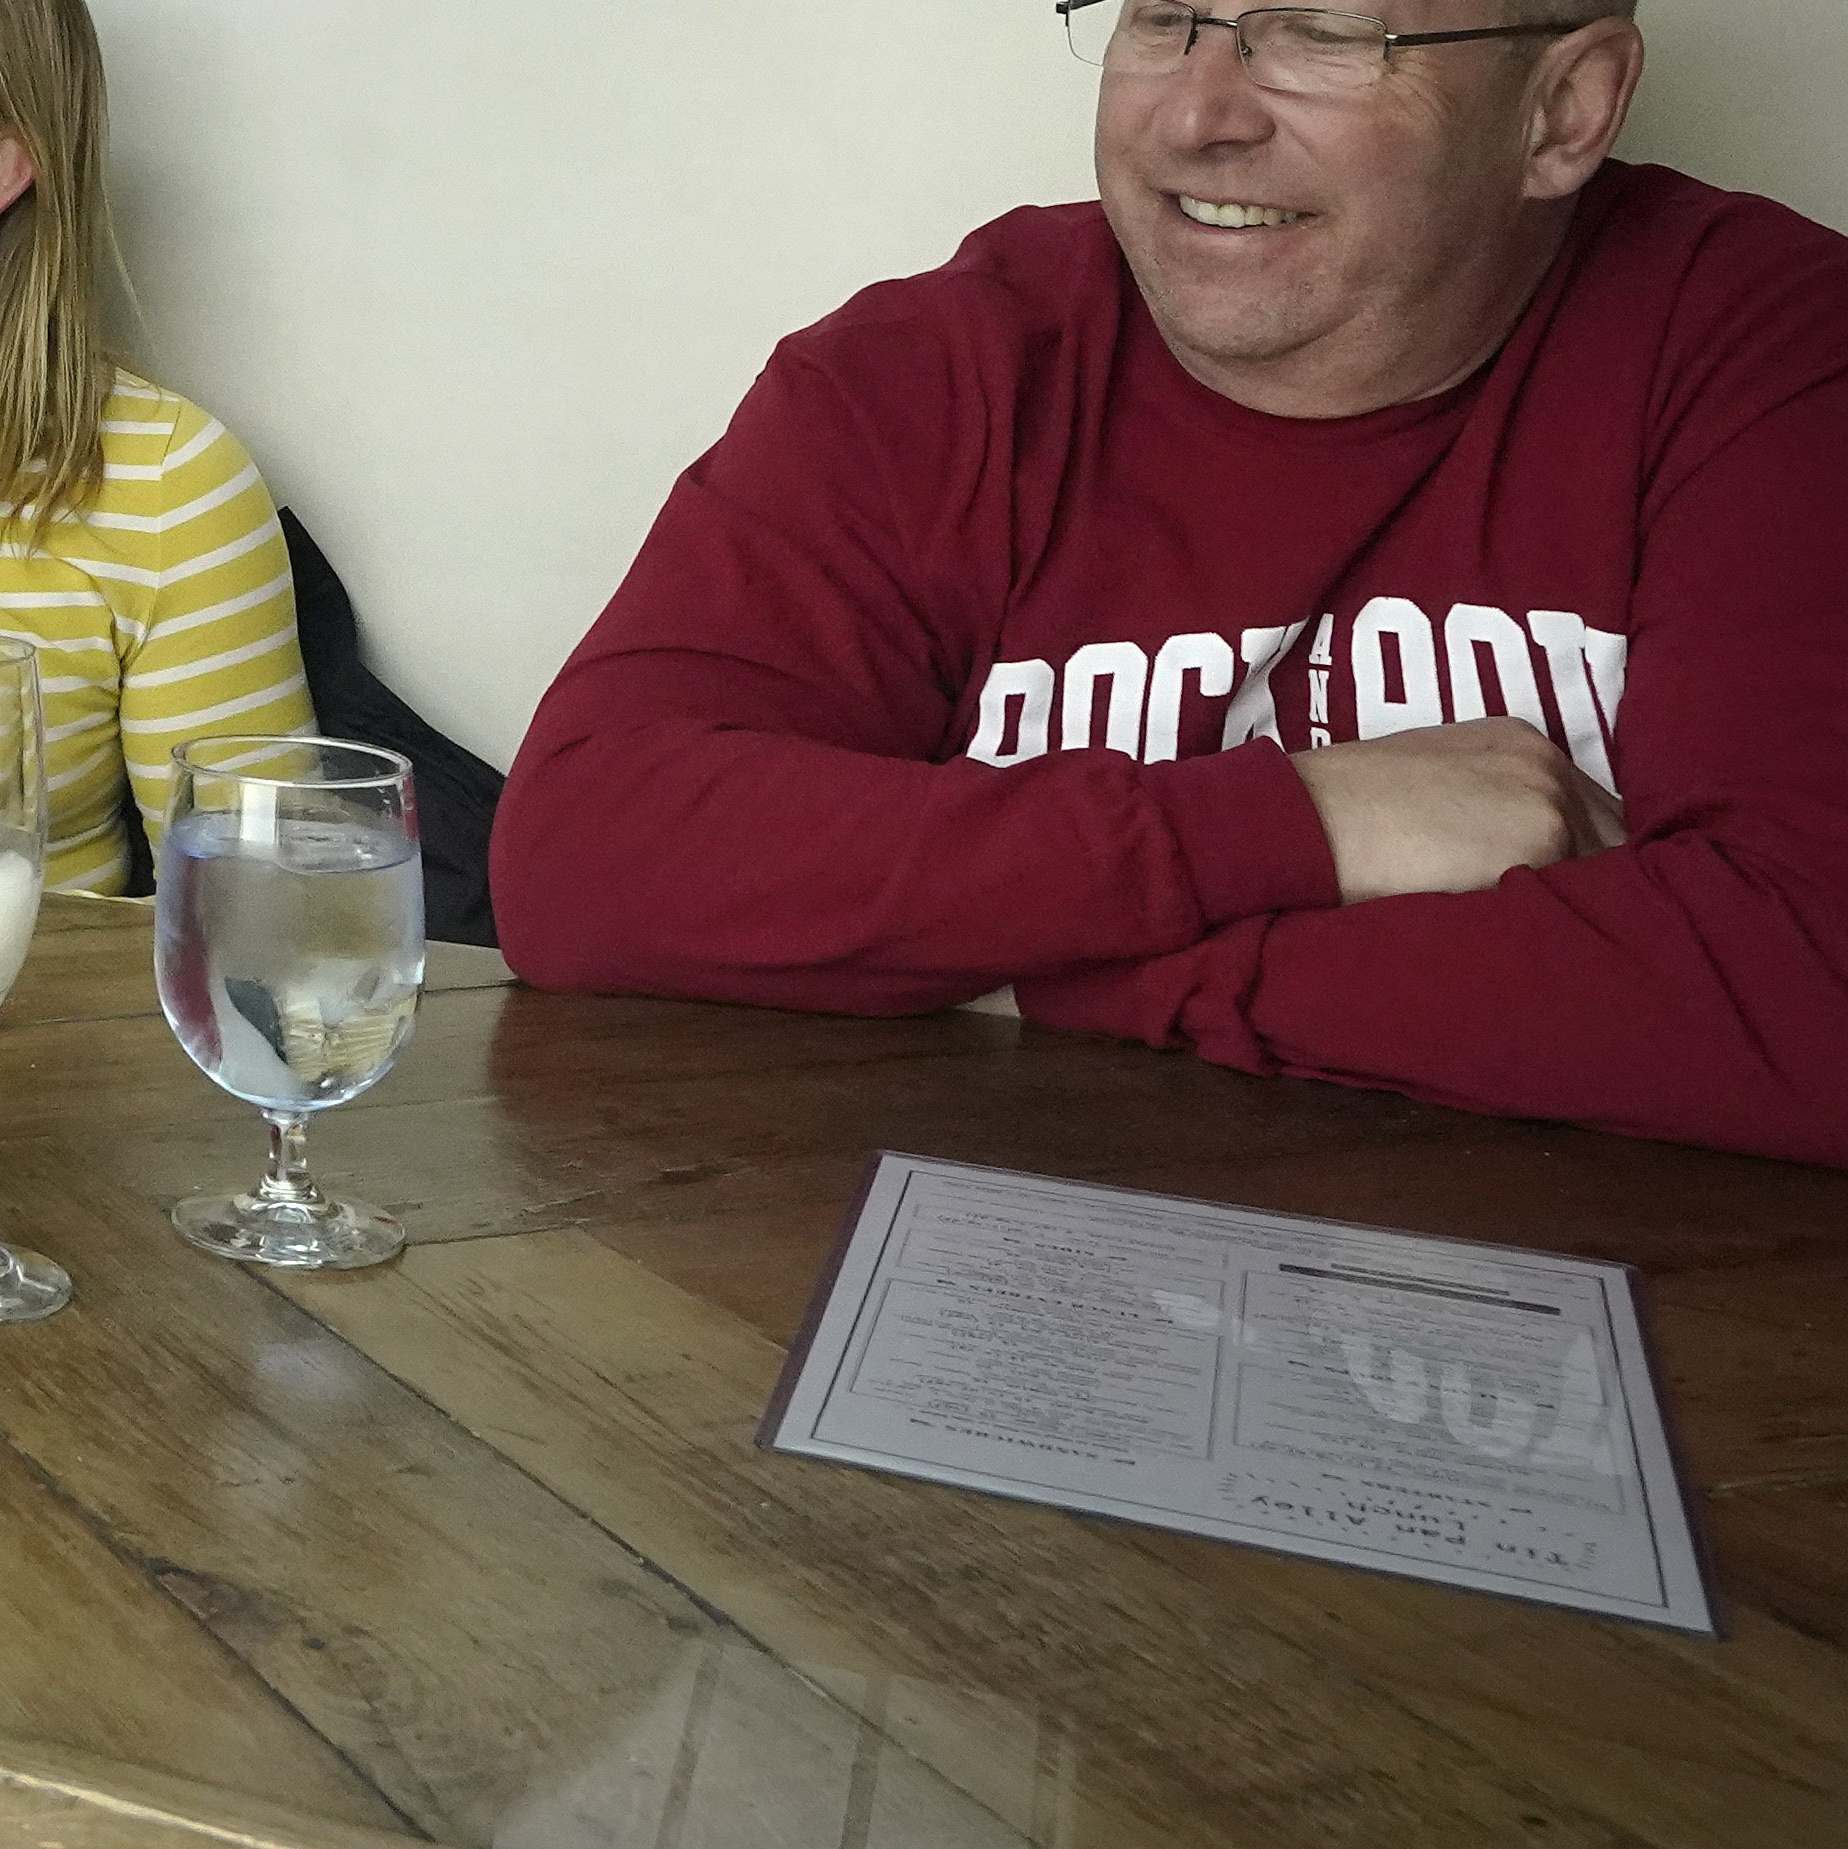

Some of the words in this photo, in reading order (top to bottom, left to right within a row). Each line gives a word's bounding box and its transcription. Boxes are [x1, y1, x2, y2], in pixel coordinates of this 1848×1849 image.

[965, 616, 1311, 769] ROCK
[1251, 1494, 1367, 1526] Alley
[1348, 1499, 1466, 1530] Lunch
[1395, 1523, 1467, 1546] Pan
[1496, 1541, 1569, 1566] Tin
